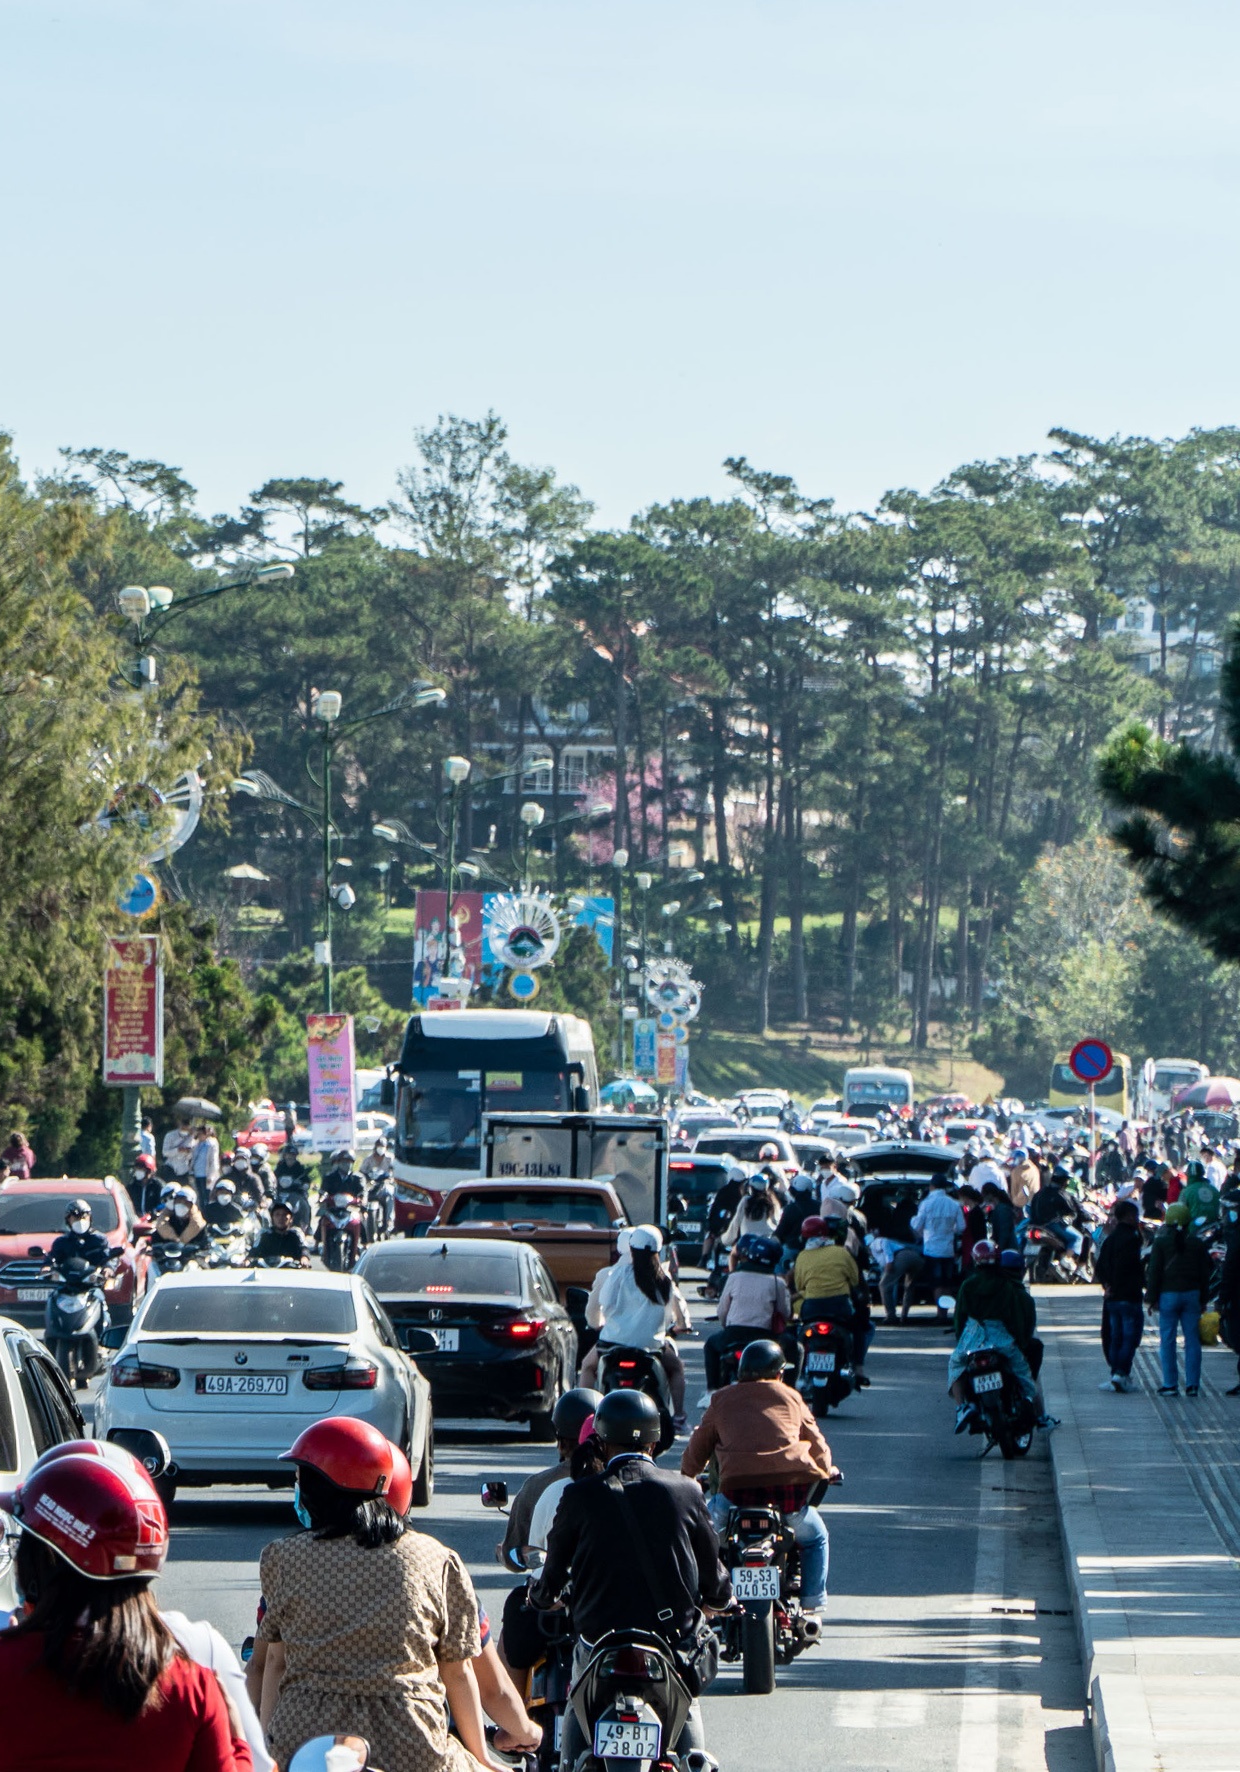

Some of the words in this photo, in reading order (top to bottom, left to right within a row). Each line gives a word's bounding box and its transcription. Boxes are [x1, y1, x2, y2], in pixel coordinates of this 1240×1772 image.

[207, 1377, 284, 1393] 49A-269.70
[87, 1529, 96, 1539] 3
[740, 1569, 772, 1583] 59-S3
[736, 1583, 776, 1598] 040.56
[606, 1724, 649, 1741] 49-B1
[600, 1740, 656, 1757] 738.02
